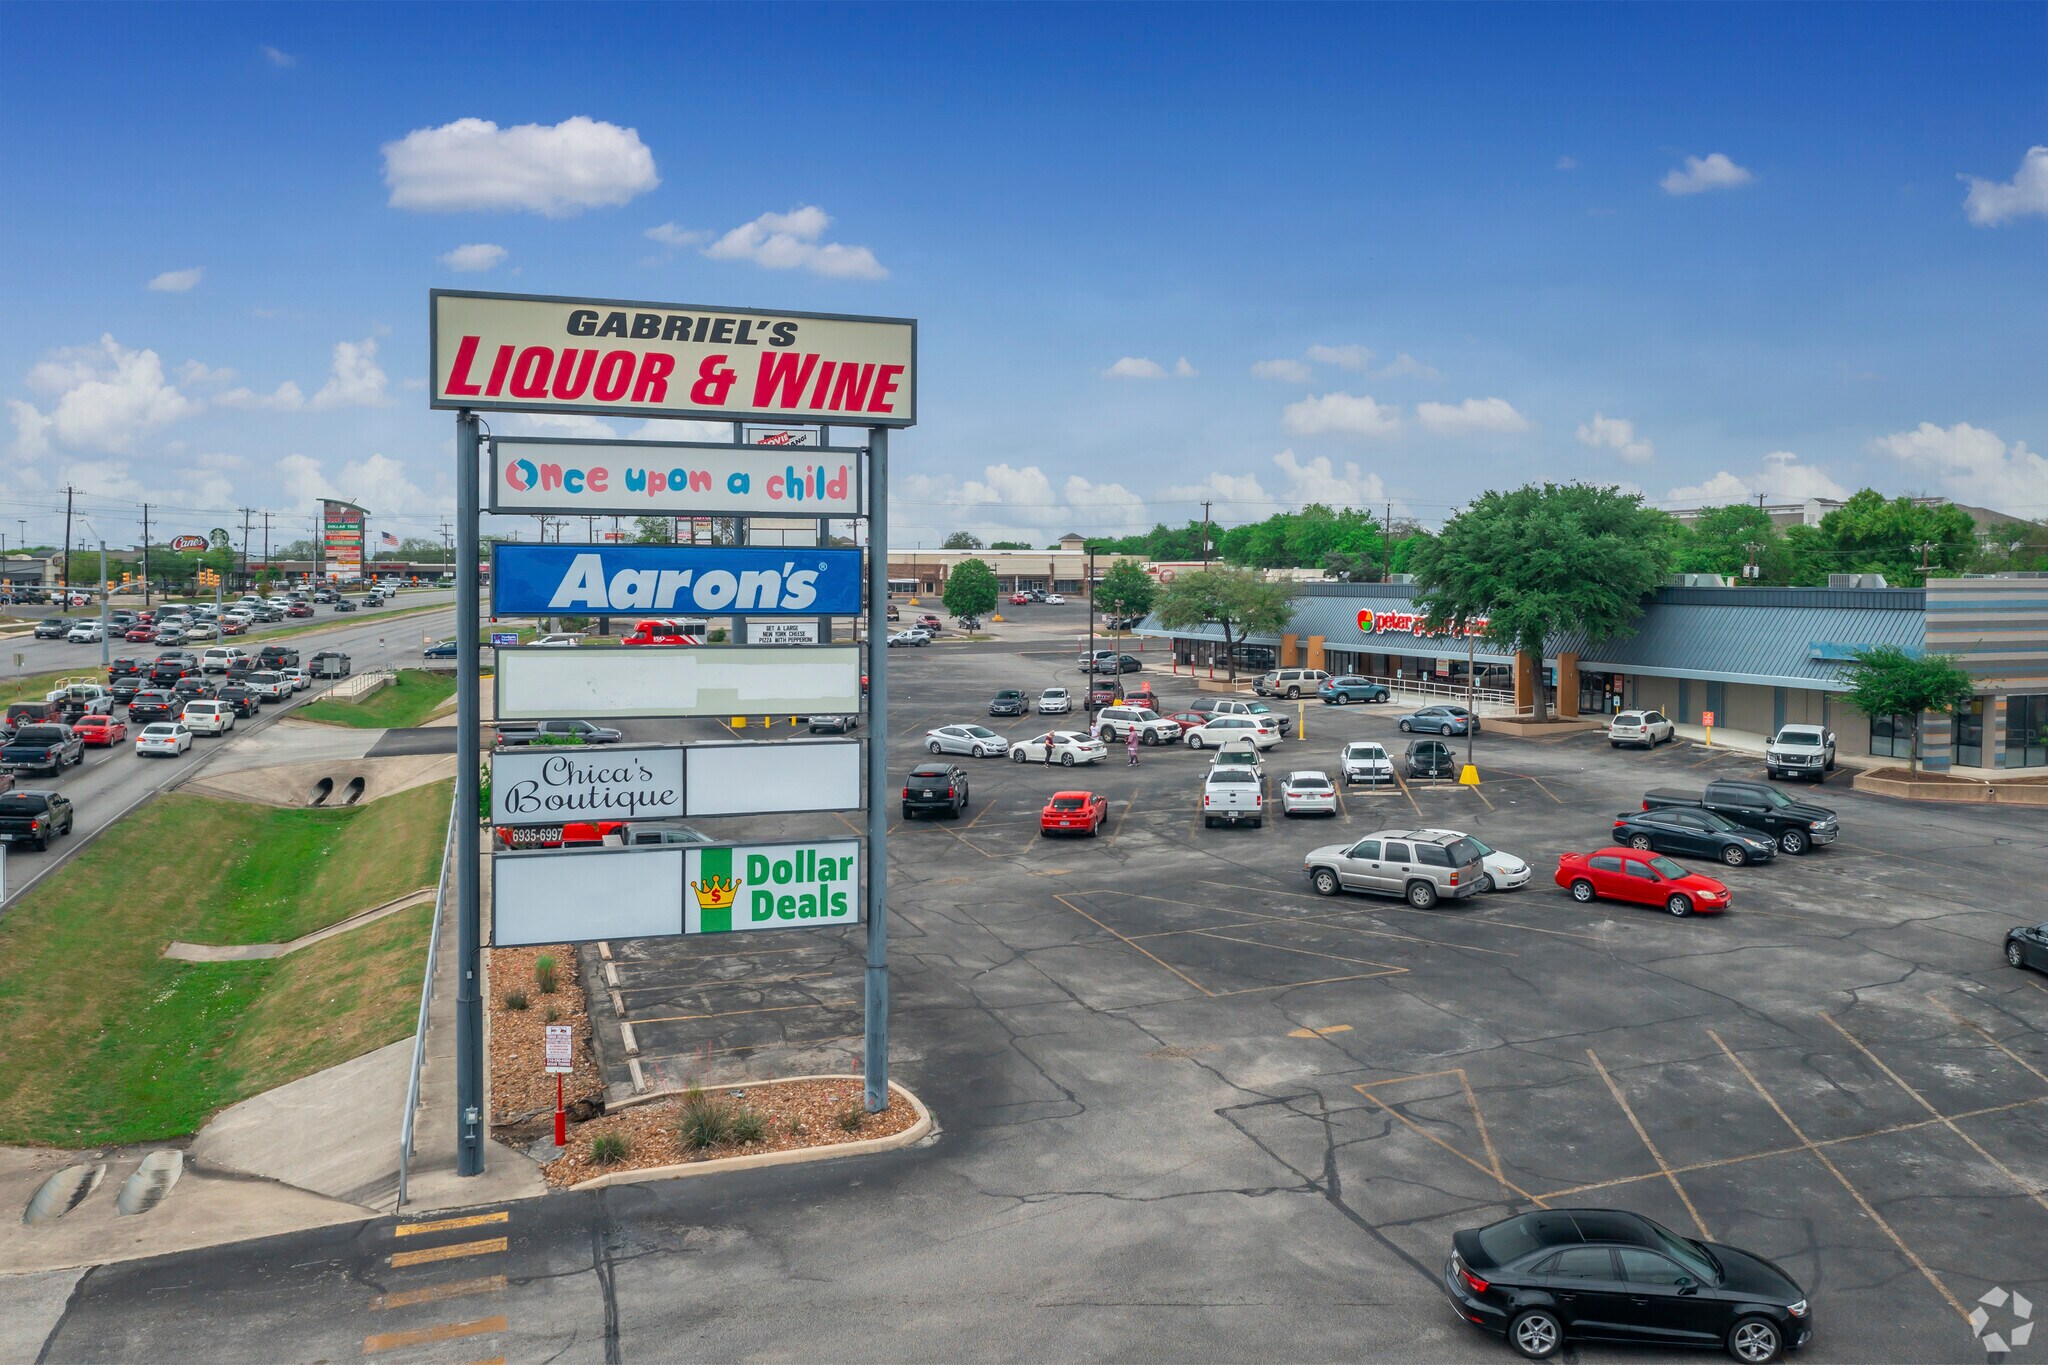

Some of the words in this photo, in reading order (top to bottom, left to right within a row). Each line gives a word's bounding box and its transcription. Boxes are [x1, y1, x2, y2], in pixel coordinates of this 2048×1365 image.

[566, 309, 798, 347] GABRIEL'S
[444, 335, 675, 403] LIQUOR
[690, 354, 737, 406] &
[752, 351, 905, 413] WINE
[505, 458, 609, 494] Once
[625, 467, 712, 497] upon
[727, 472, 750, 495] a
[766, 465, 848, 501] child
[172, 536, 203, 551] Cane's
[1375, 612, 1412, 632] peter
[542, 756, 653, 786] Chica's
[505, 780, 678, 816] Boutique
[512, 828, 563, 842] 6935-6997
[747, 849, 853, 885] Dollar
[752, 884, 848, 921] Deals
